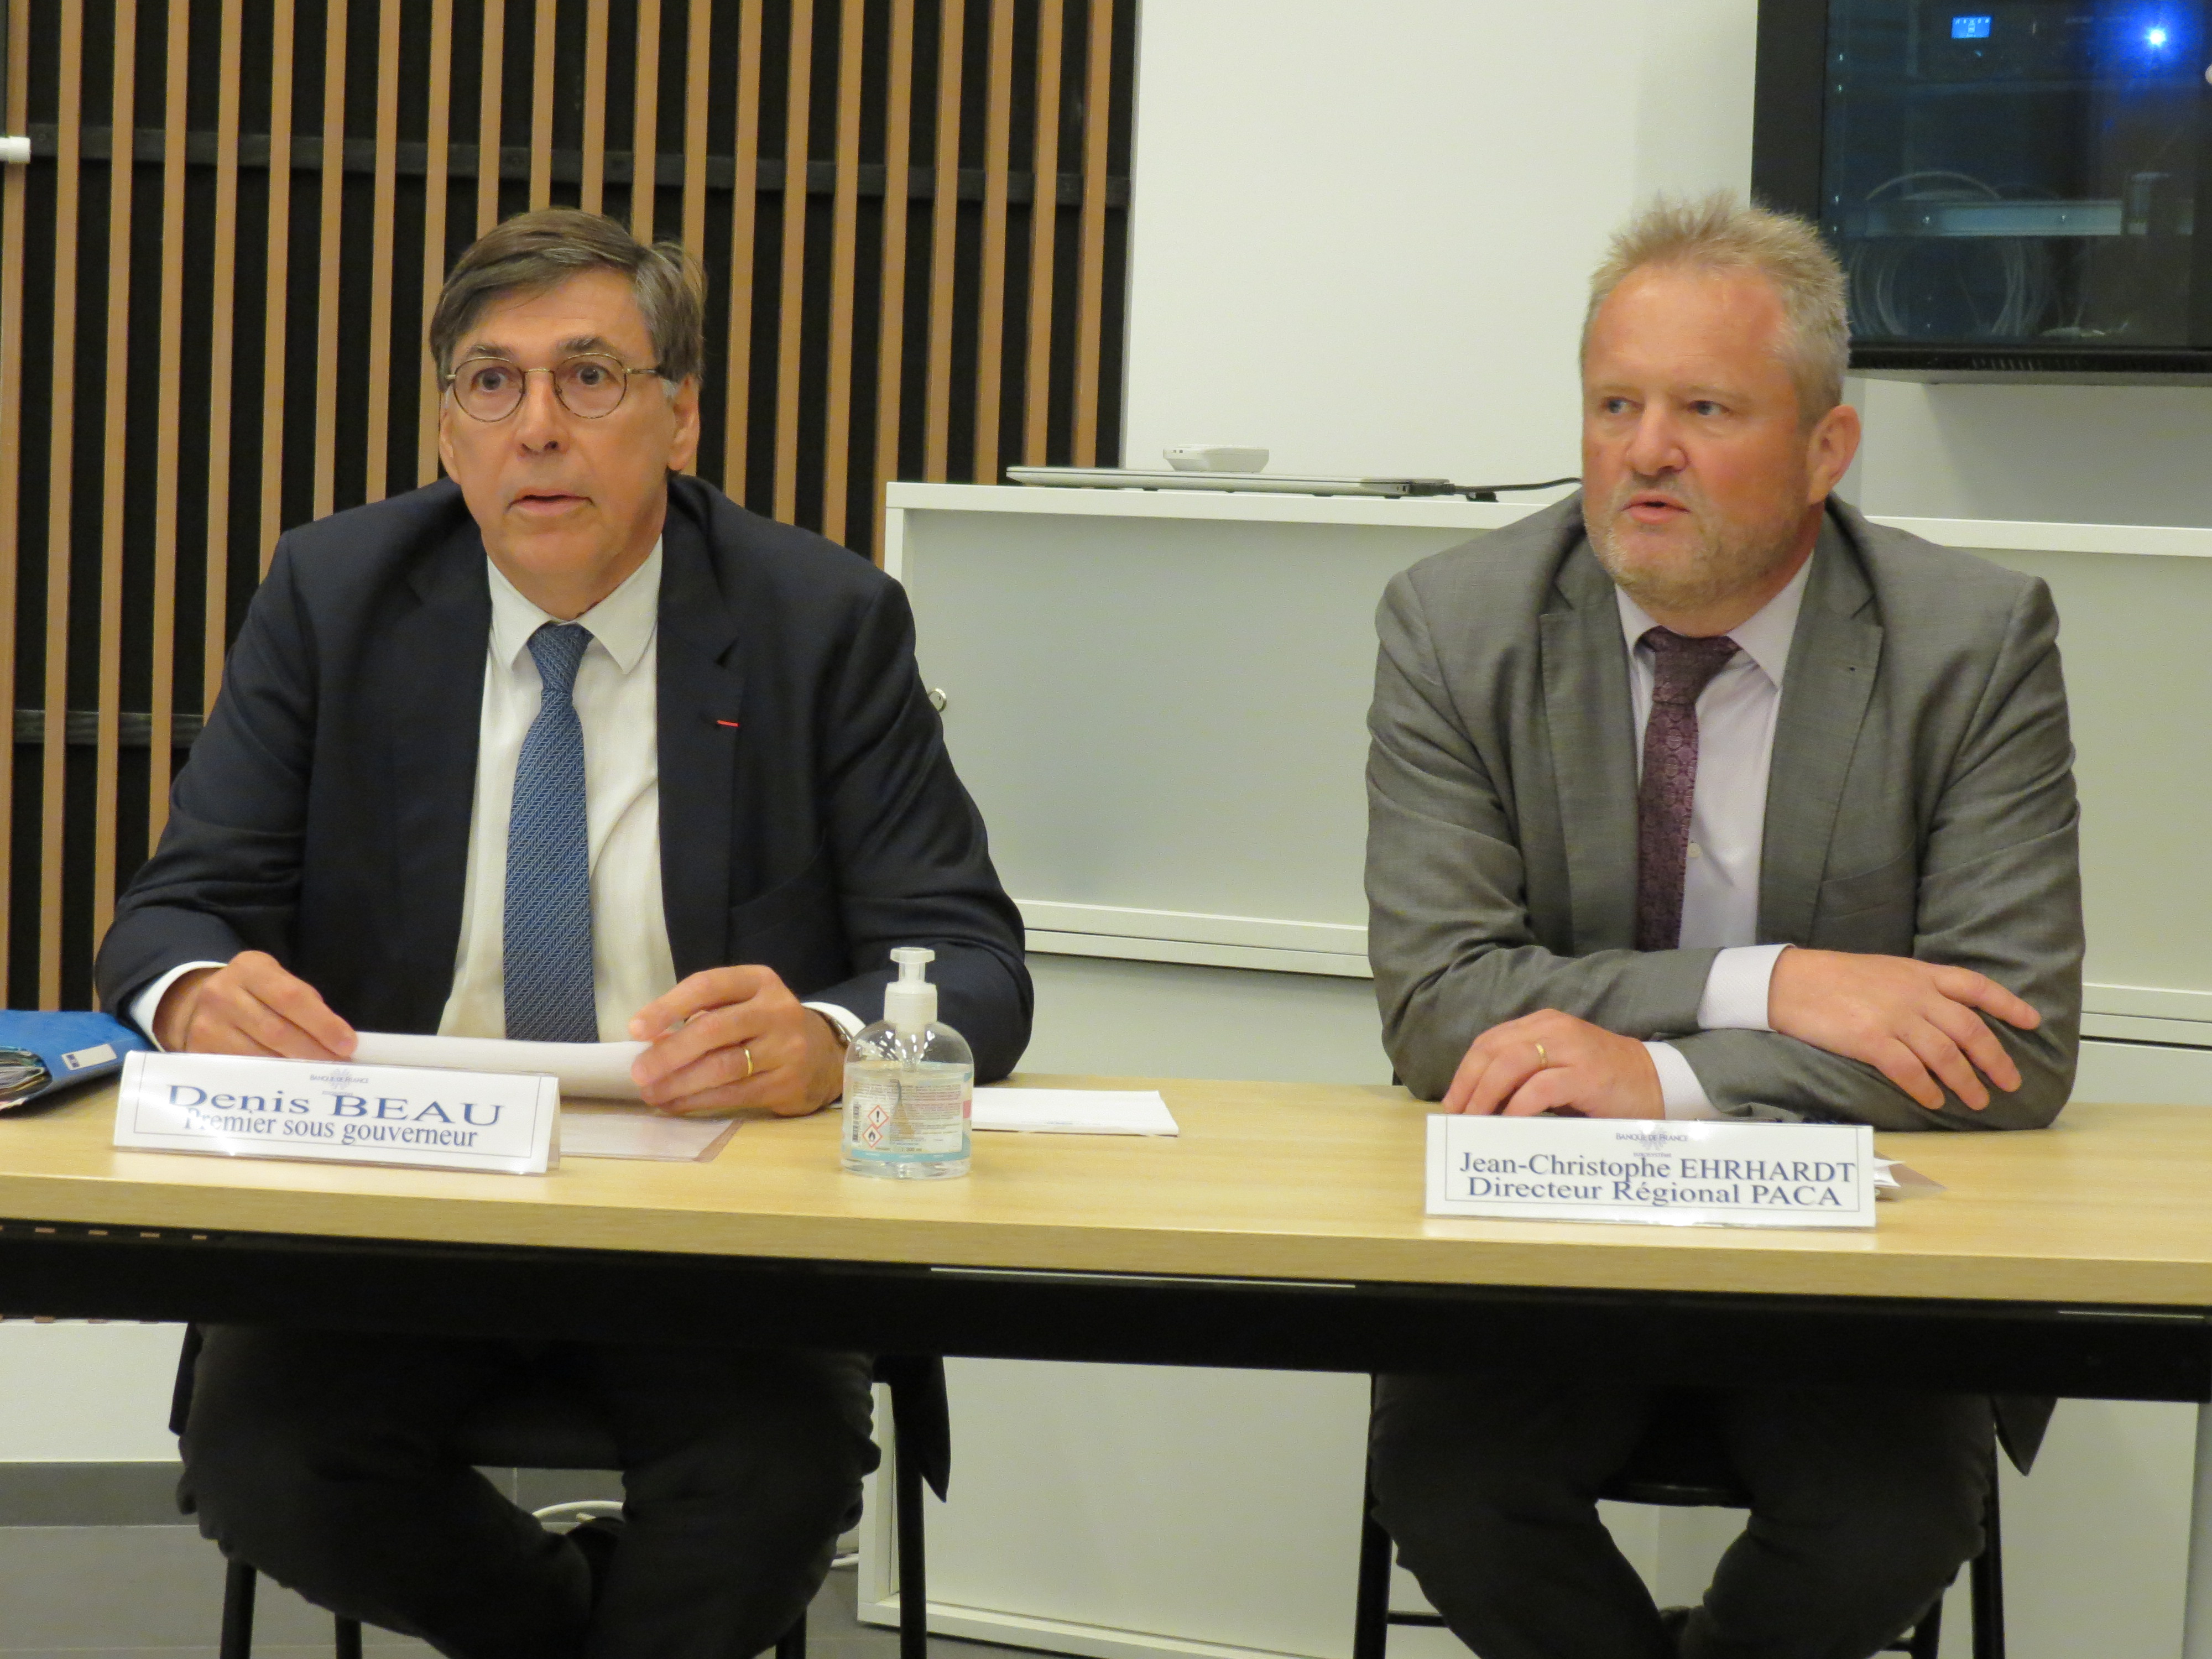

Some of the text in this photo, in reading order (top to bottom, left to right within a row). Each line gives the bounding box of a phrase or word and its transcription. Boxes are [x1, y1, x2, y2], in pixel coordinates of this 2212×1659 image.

[167, 1084, 504, 1126] Denis BEAU
[283, 1119, 335, 1138] sous
[341, 1122, 478, 1147] gouverneur
[1459, 1152, 1856, 1182] Jean-Christophe EHRHARDT
[1467, 1176, 1842, 1207] Directeur Régional PACA
